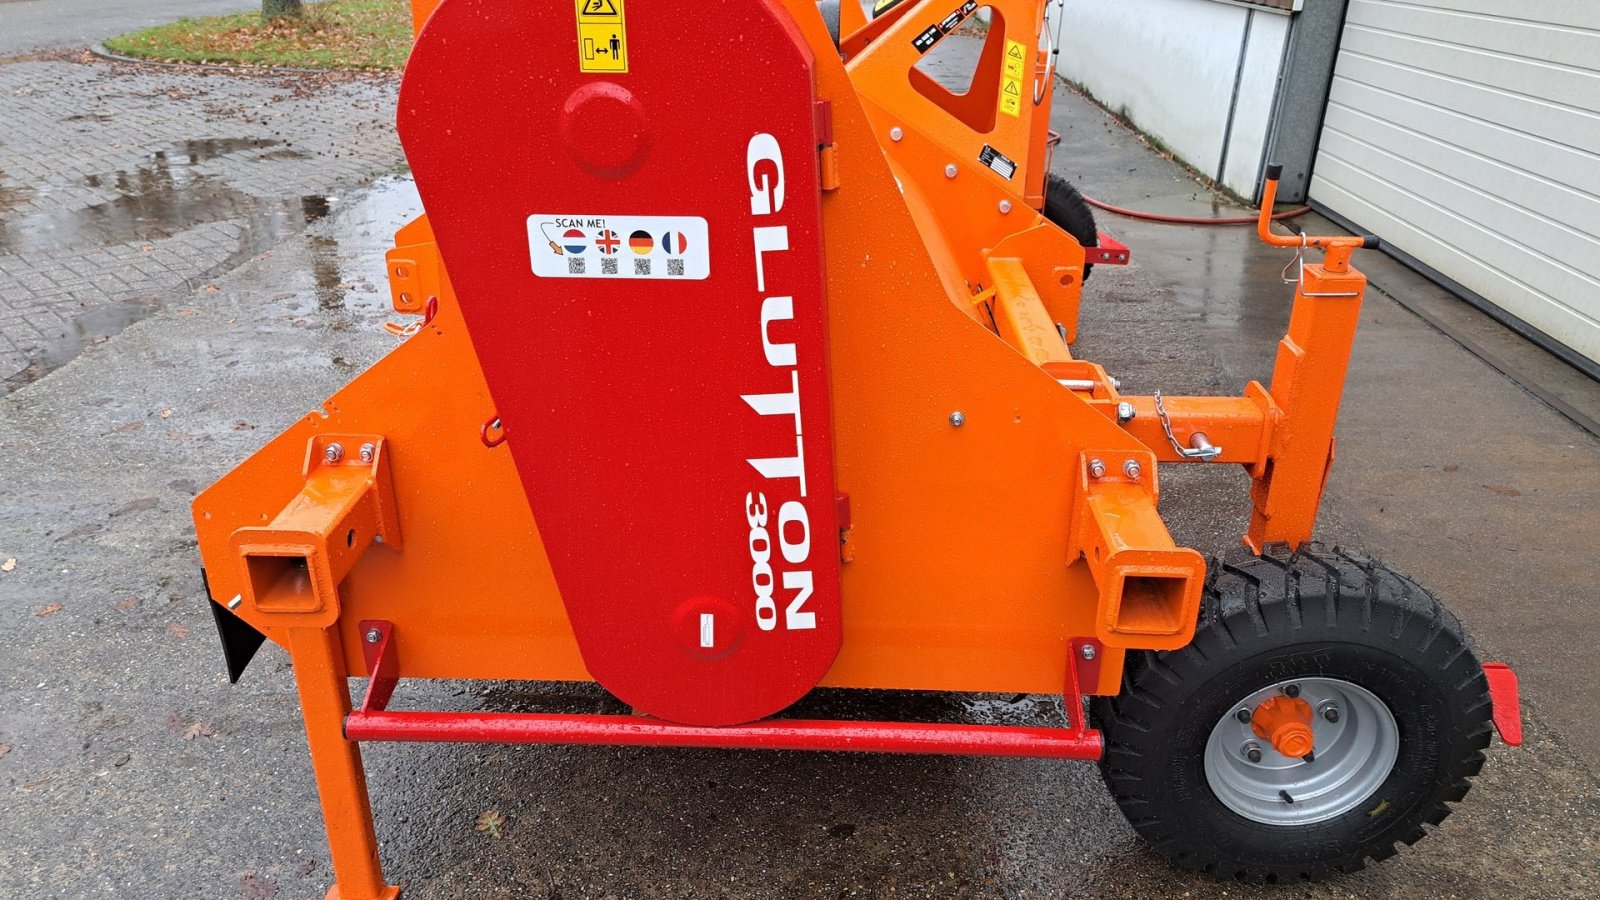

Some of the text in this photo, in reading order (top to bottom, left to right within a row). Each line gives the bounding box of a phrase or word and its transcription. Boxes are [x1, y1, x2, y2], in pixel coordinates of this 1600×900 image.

[555, 218, 606, 229] SCAN ME!
[740, 133, 817, 630] GLUTTON
[745, 492, 777, 631] 3000
